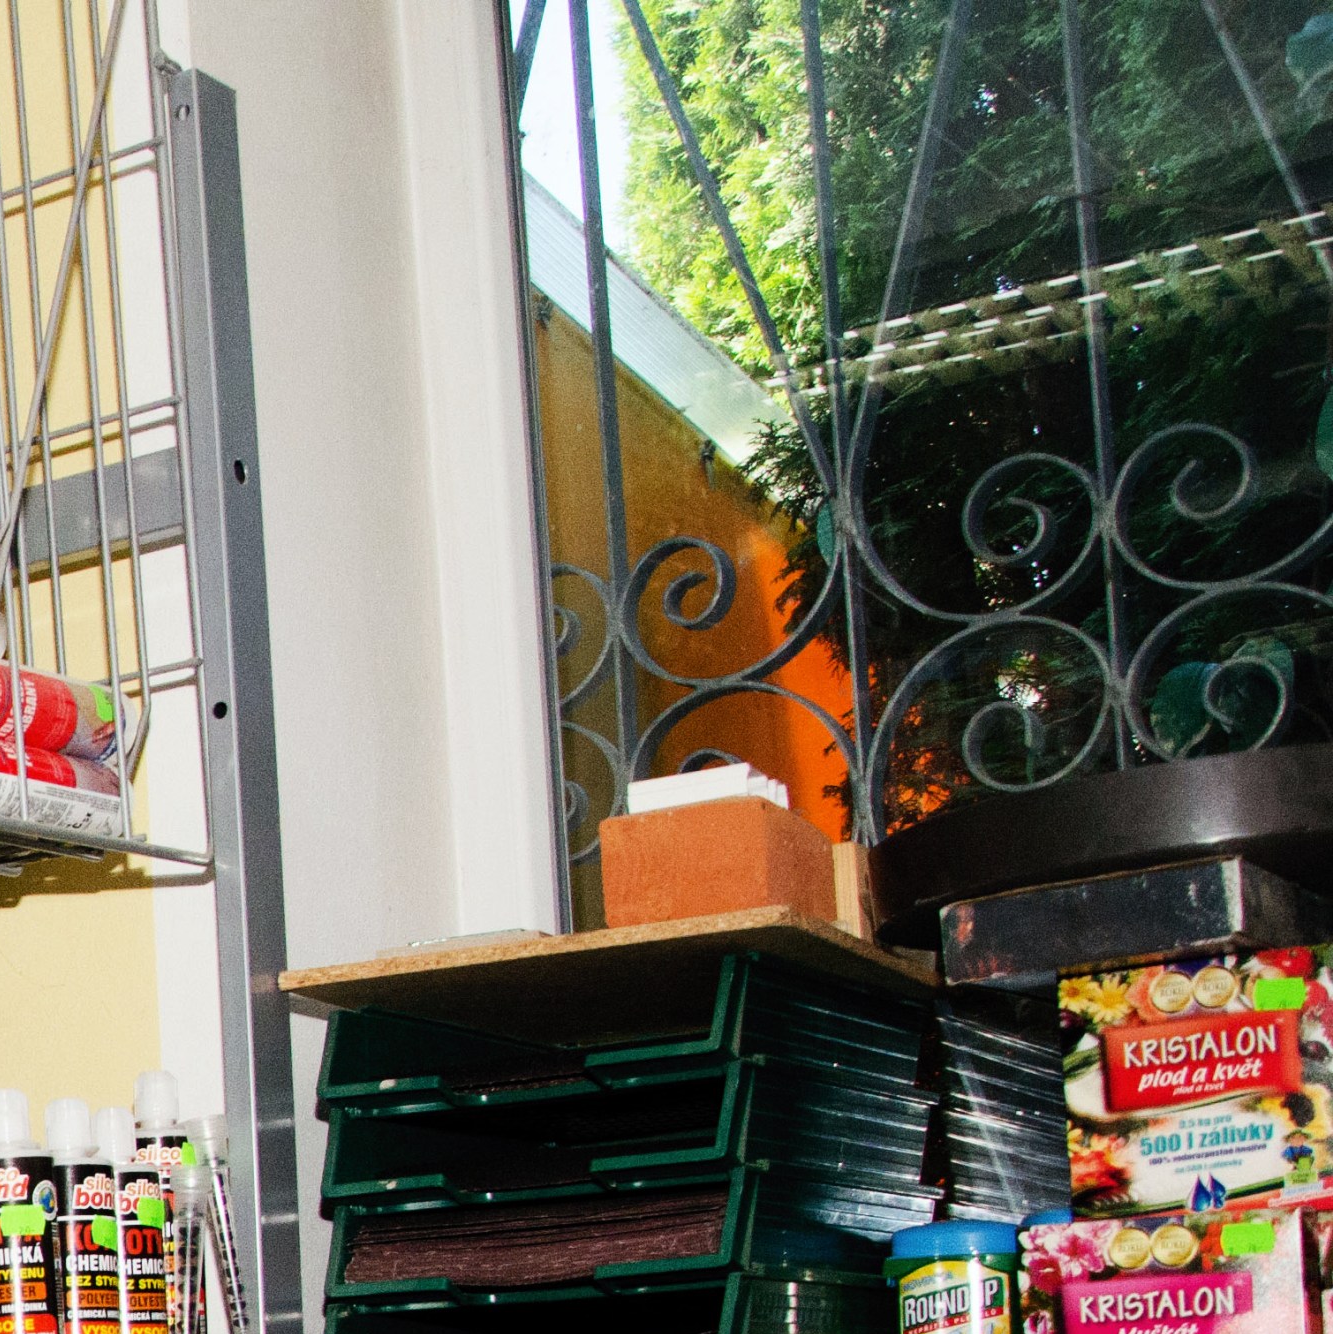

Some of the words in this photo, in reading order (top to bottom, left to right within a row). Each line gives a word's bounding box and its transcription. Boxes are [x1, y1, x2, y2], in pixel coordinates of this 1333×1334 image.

[1123, 1023, 1277, 1069] KRISTALON
[1137, 1065, 1188, 1093] plod
[1191, 1068, 1208, 1083] a
[1212, 1057, 1264, 1082] květ
[136, 1146, 182, 1163] silco
[1140, 1134, 1182, 1158] 500
[1199, 1120, 1275, 1150] zálivky
[904, 1279, 999, 1328] ROUNDP
[1079, 1285, 1236, 1324] KRISTALON
